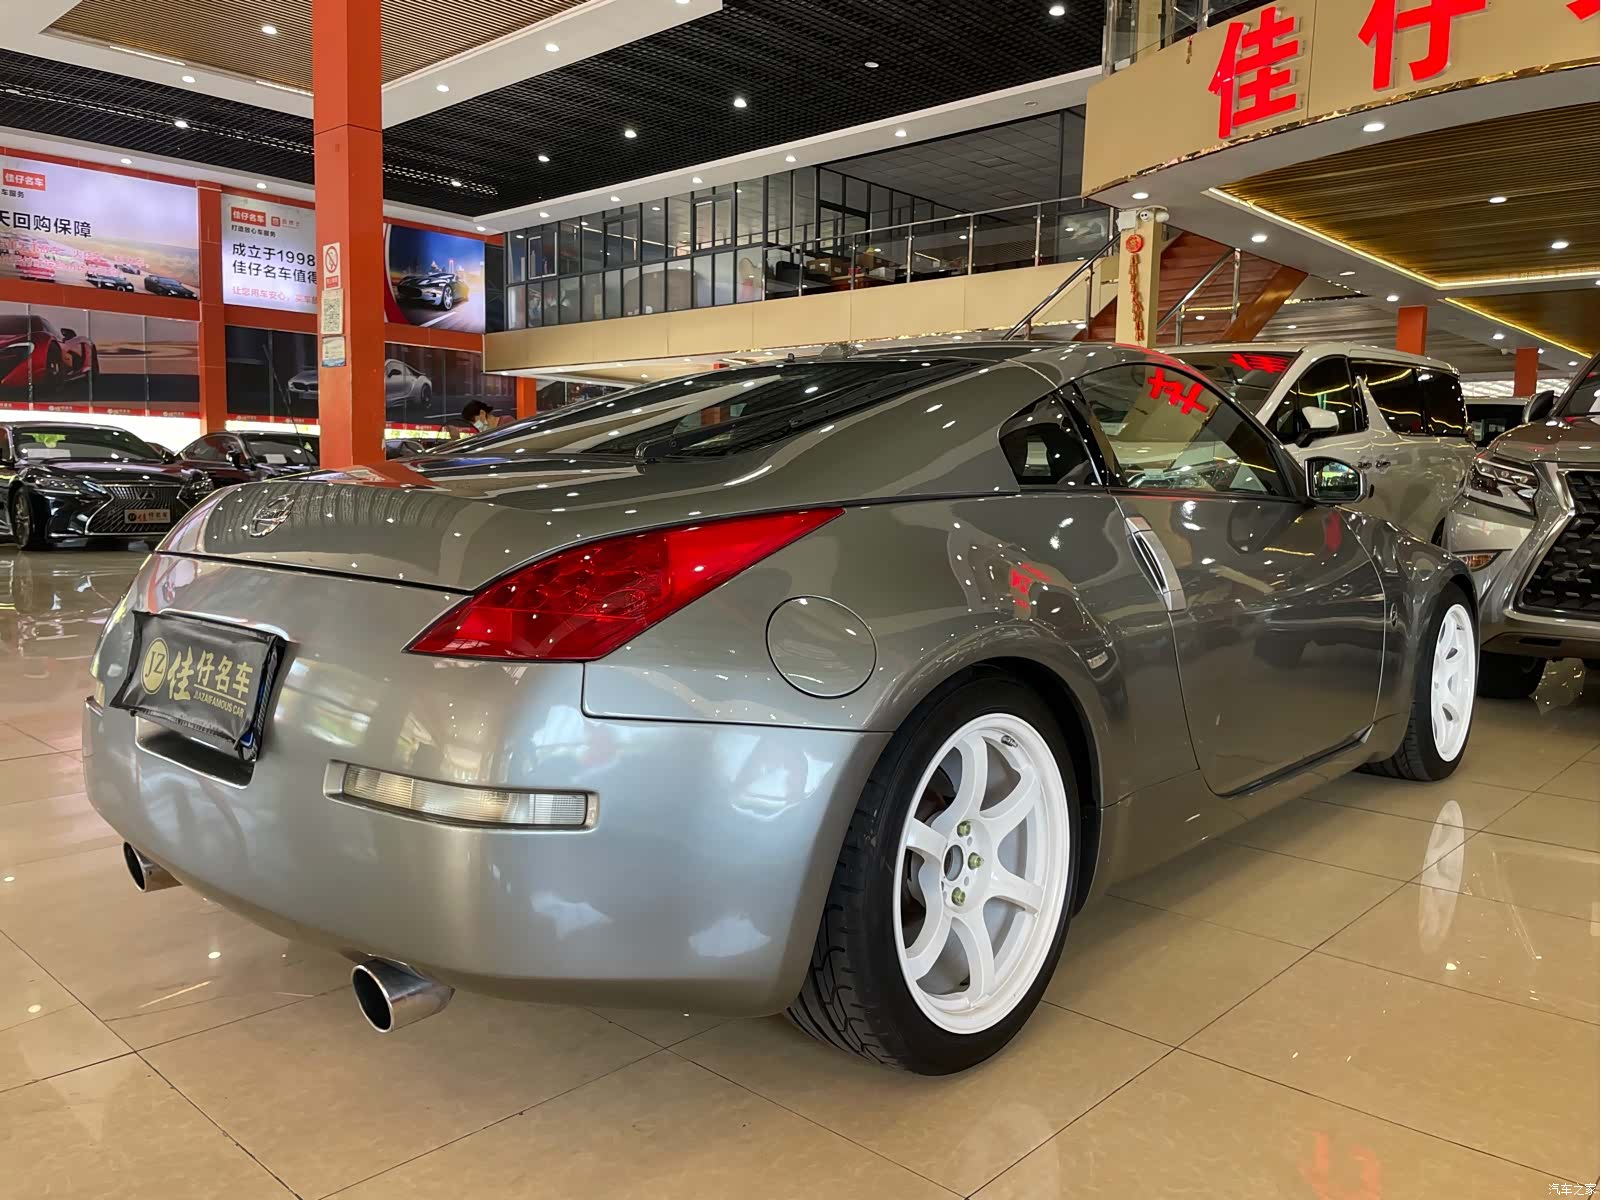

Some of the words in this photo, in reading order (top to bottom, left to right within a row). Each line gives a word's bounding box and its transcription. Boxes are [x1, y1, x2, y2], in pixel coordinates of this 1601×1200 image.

[1207, 0, 1601, 140] 佳仔
[5, 172, 44, 187] 佳仔名车
[232, 210, 265, 224] 佳仔名车
[231, 224, 276, 238] 打造放心车服务
[232, 242, 316, 267] 成立于1998
[145, 650, 166, 678] JZ
[167, 645, 253, 701] 佳仔名车
[232, 704, 245, 718] CAR
